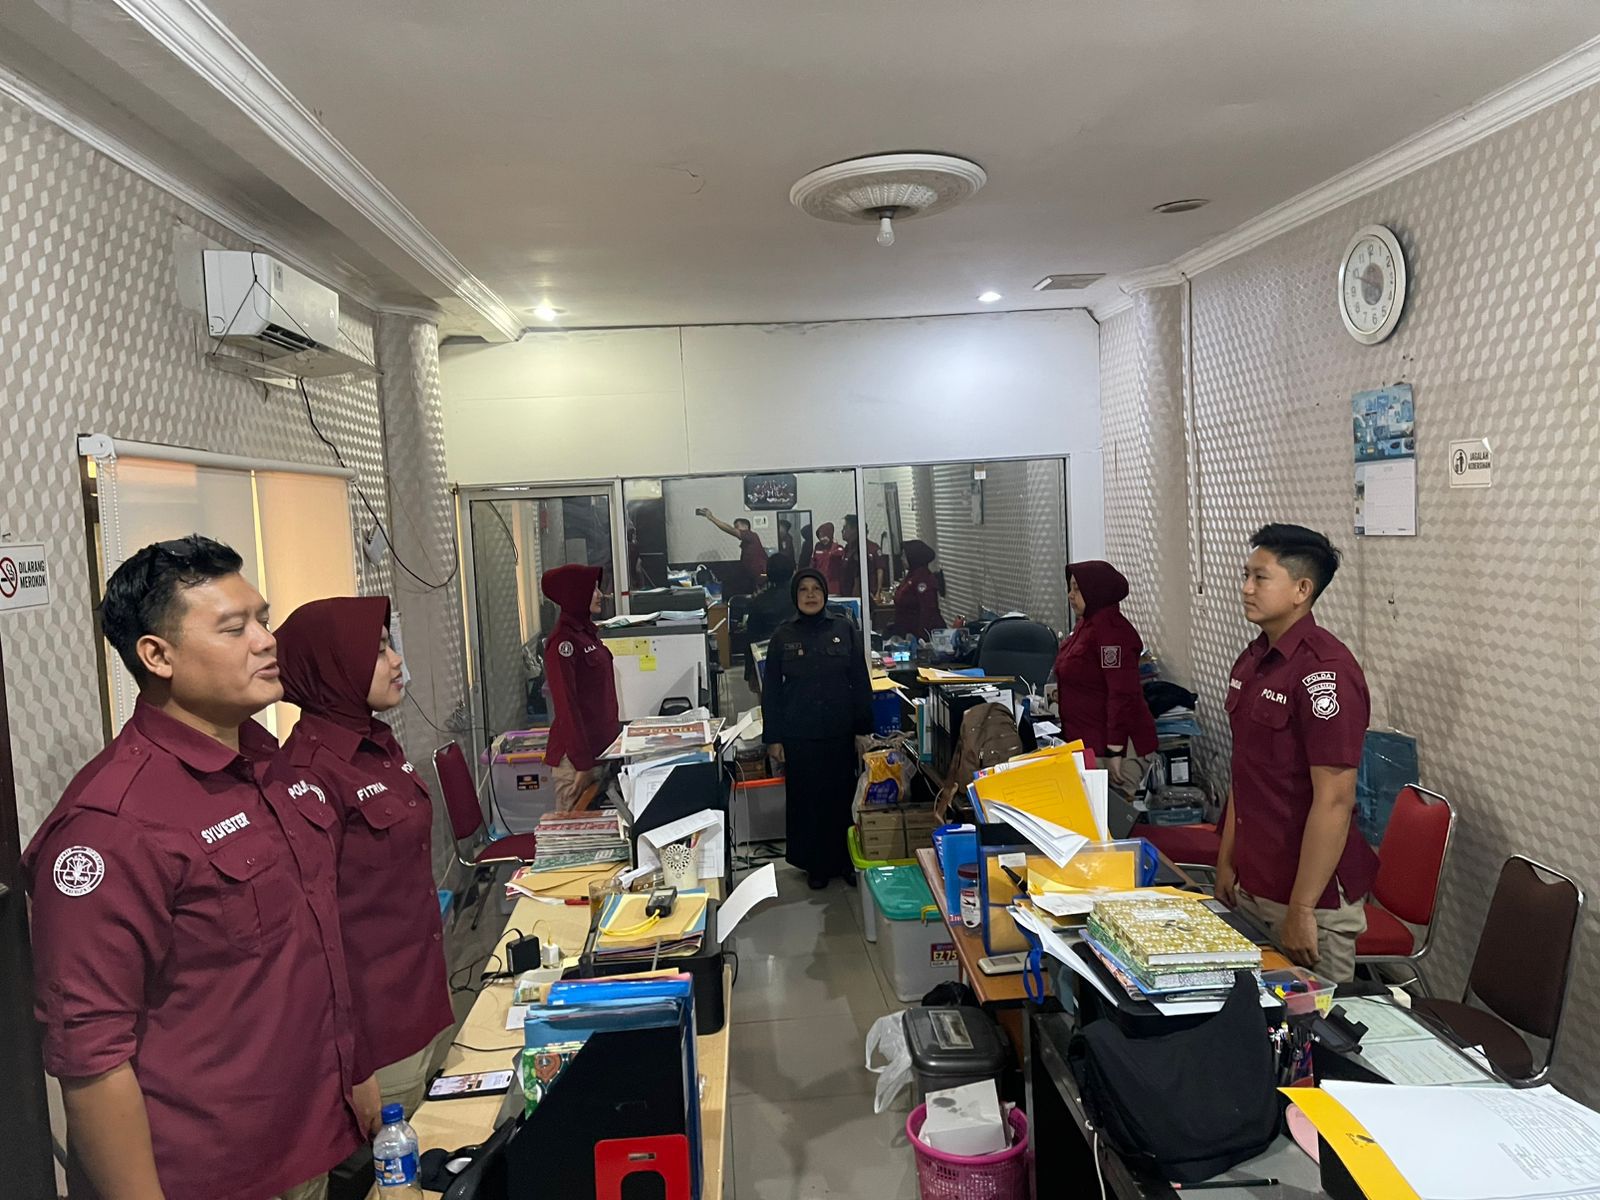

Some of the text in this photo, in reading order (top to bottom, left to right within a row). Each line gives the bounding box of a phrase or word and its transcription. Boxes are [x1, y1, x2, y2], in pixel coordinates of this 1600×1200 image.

[18, 560, 45, 574] DILARANG
[20, 574, 47, 589] MEROKOK
[1306, 672, 1332, 684] POLDA
[1261, 688, 1287, 704] POLRI
[356, 782, 388, 801] FITRIA
[201, 812, 250, 844] SYLVESTER
[945, 951, 958, 961] 75
